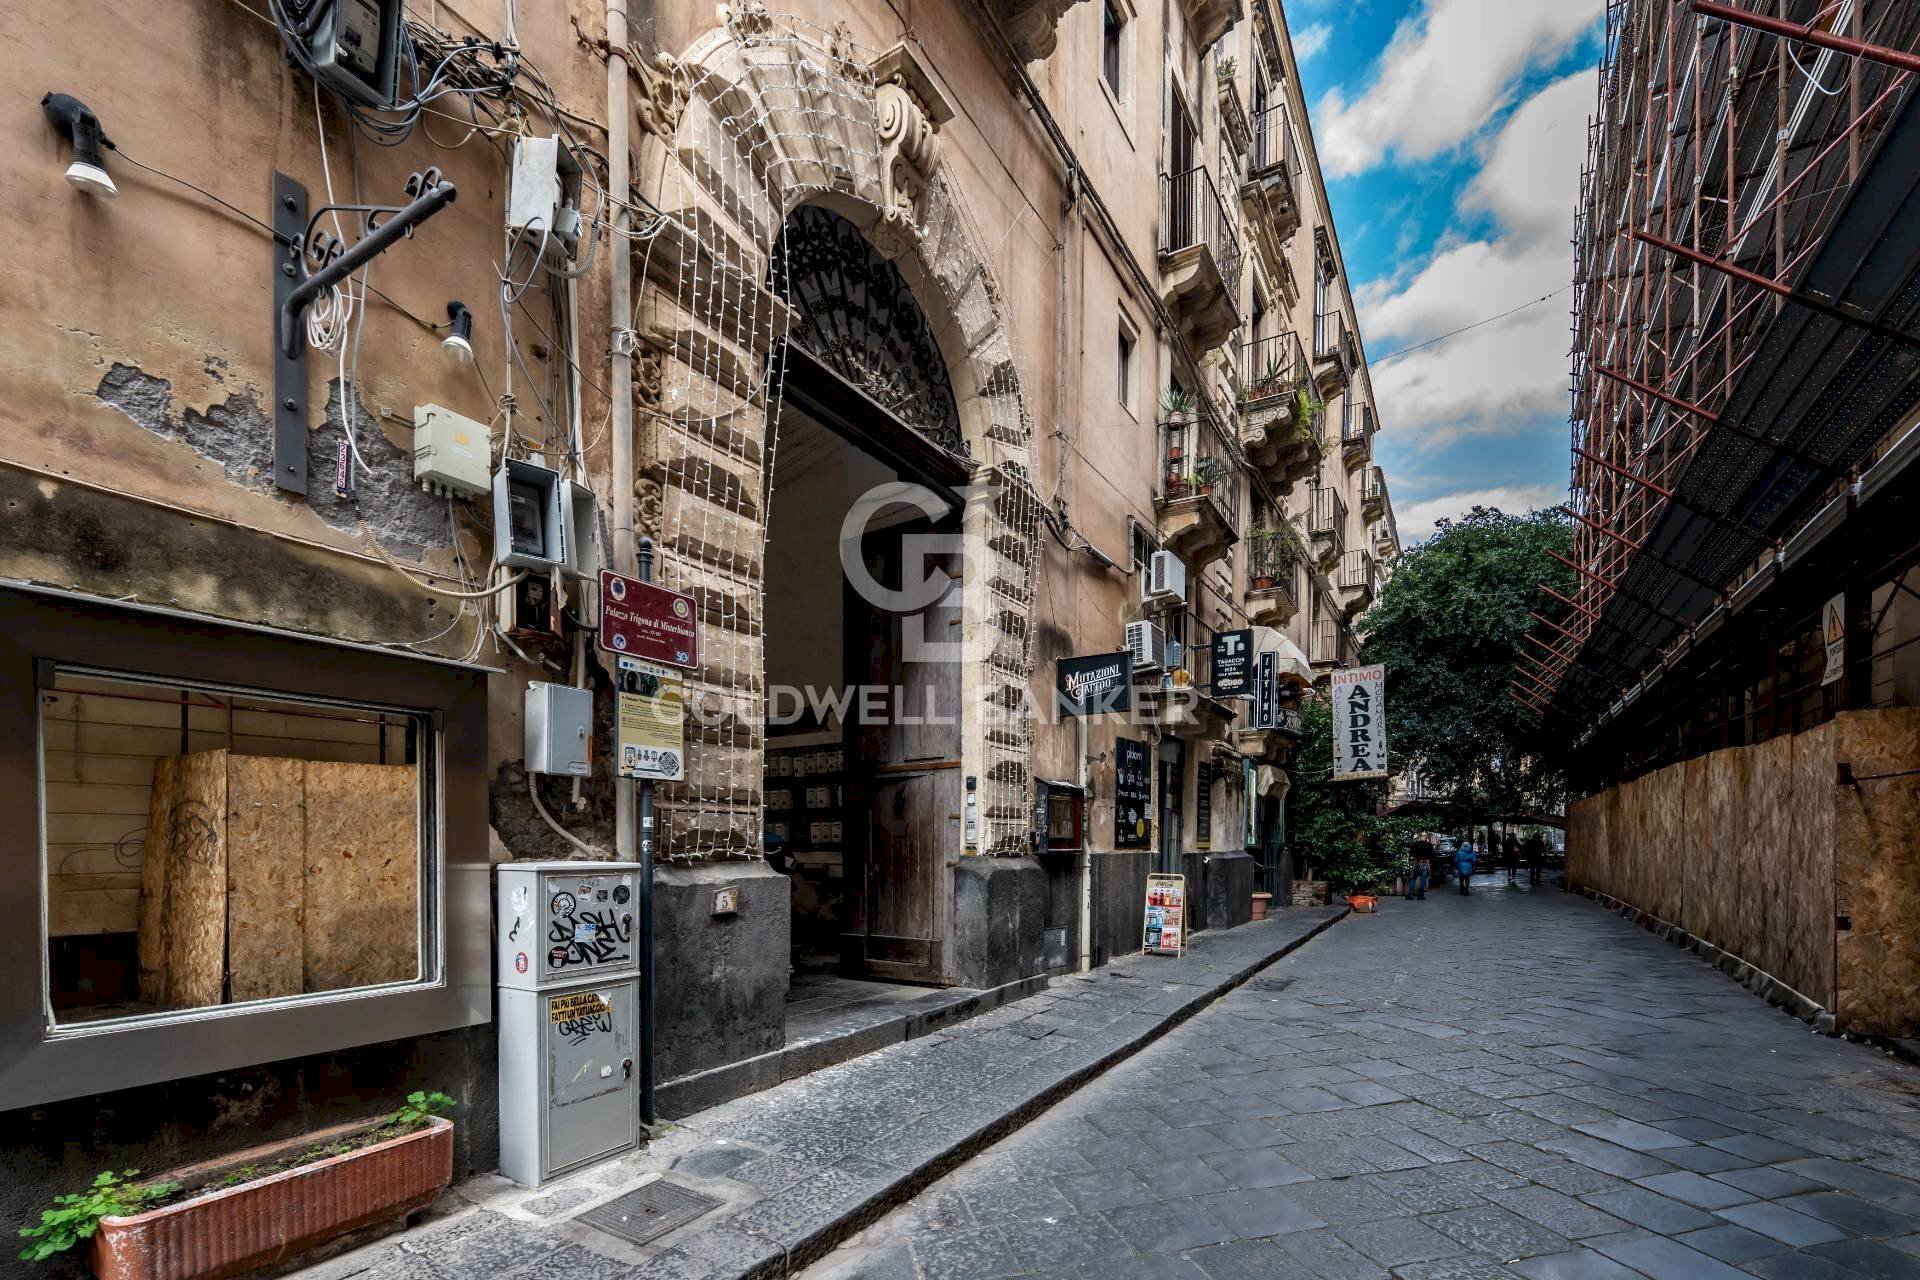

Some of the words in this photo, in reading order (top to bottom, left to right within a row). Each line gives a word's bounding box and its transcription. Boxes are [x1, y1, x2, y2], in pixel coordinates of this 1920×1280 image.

[605, 605, 628, 620] Palazzo
[630, 611, 652, 627] Trigona
[653, 619, 660, 629] di
[660, 620, 695, 638] Misterbianco
[1222, 634, 1241, 656] T
[1065, 664, 1119, 691] MUTAZIONI
[1334, 670, 1383, 685] INTIMO
[1071, 679, 1111, 706] TATTOO
[1347, 685, 1373, 772] ANDREA
[552, 1000, 560, 1011] FAI
[570, 995, 587, 1007] BELLA
[552, 1010, 567, 1022] FATTI
[567, 1008, 576, 1019] UN
[576, 1003, 605, 1017] TATUAGGIO
